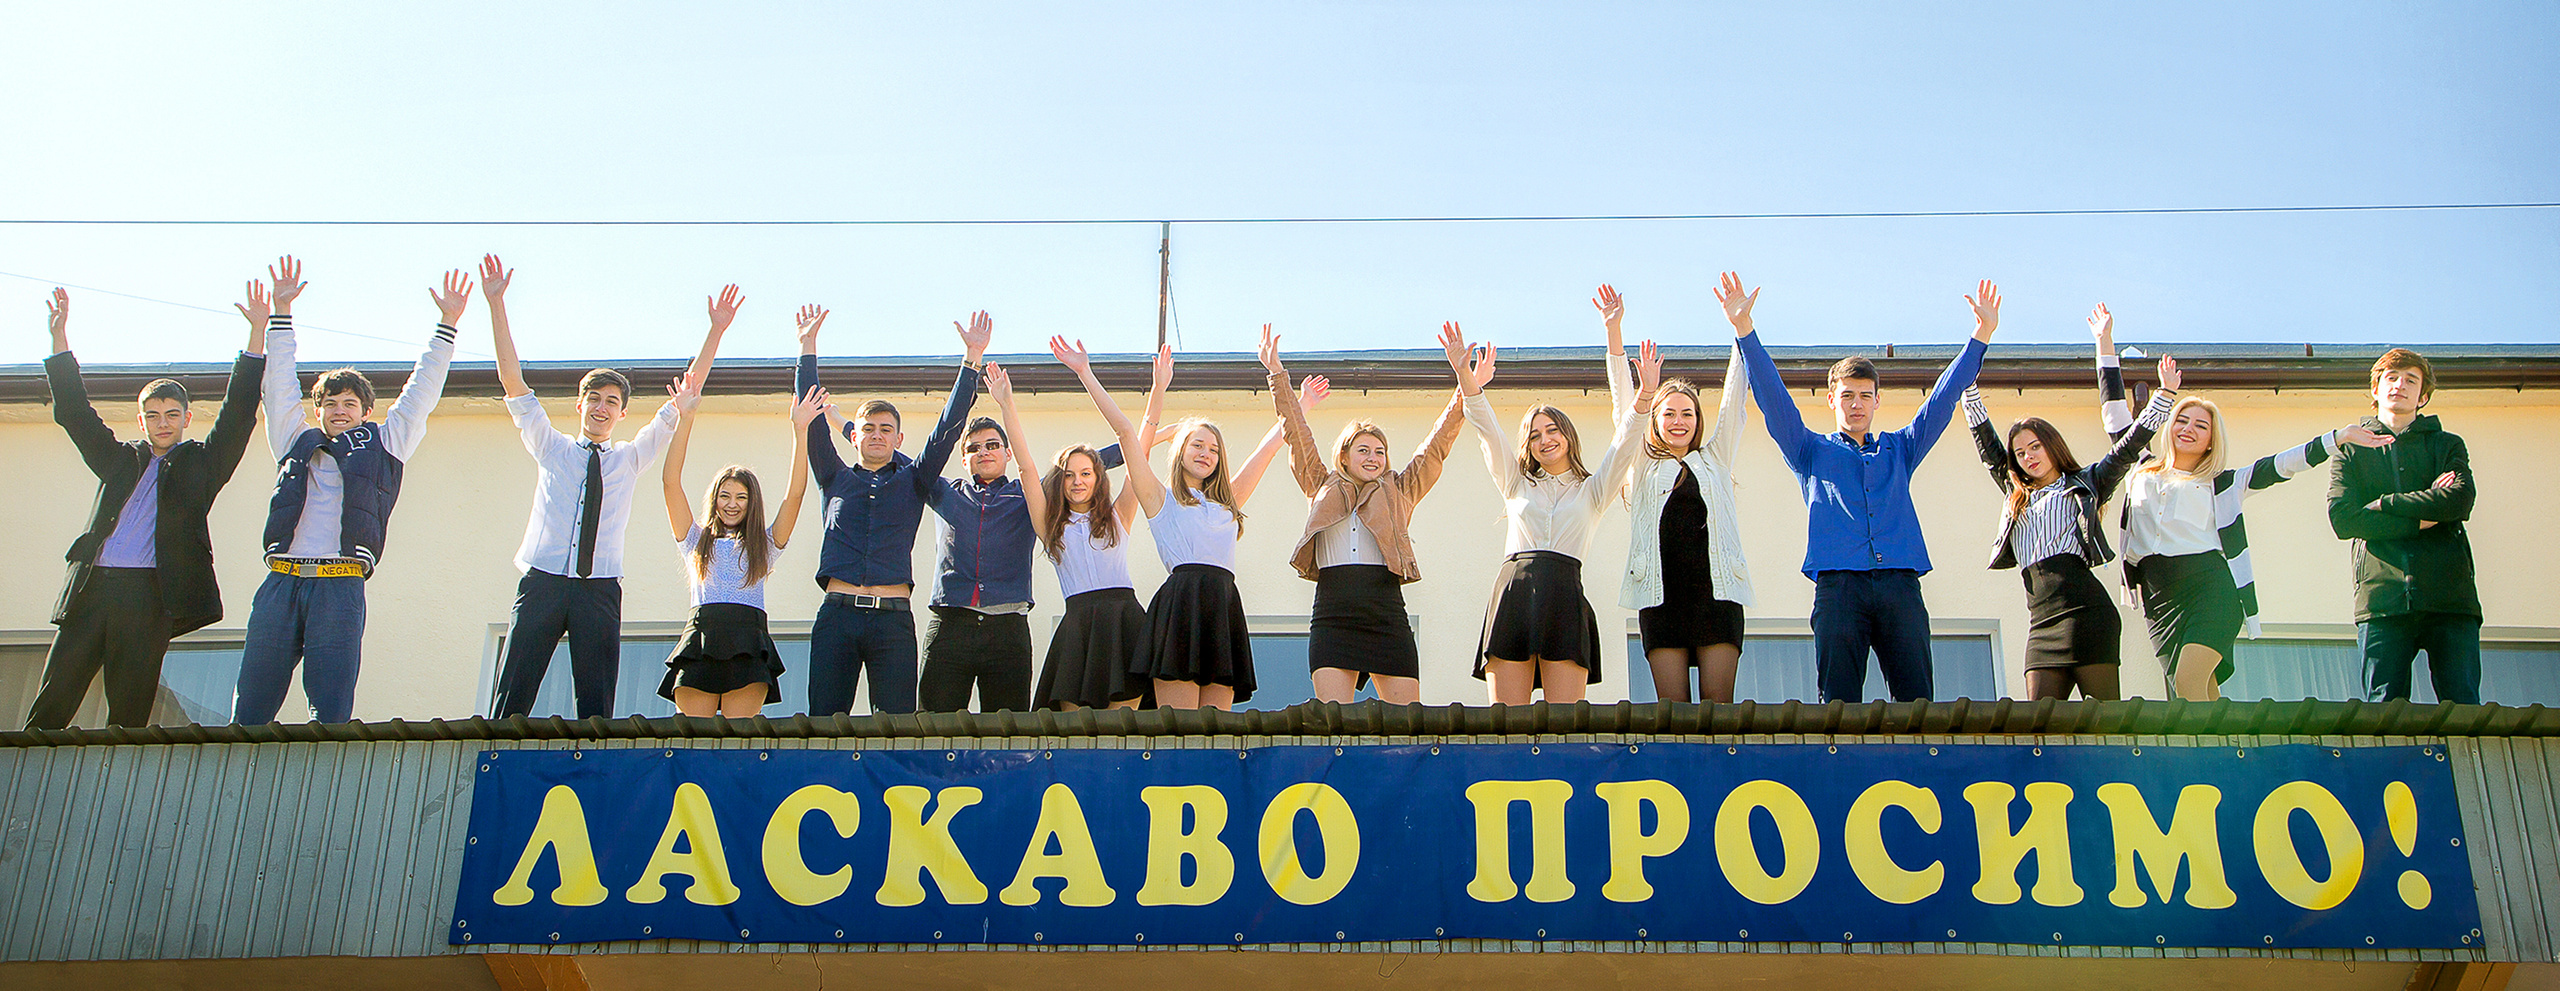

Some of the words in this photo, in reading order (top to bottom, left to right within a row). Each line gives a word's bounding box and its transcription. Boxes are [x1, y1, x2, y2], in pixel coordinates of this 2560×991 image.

[342, 426, 372, 450] P
[492, 781, 1361, 907] ЛАСКАВО
[1465, 779, 2432, 911] ПРОСИМО!
